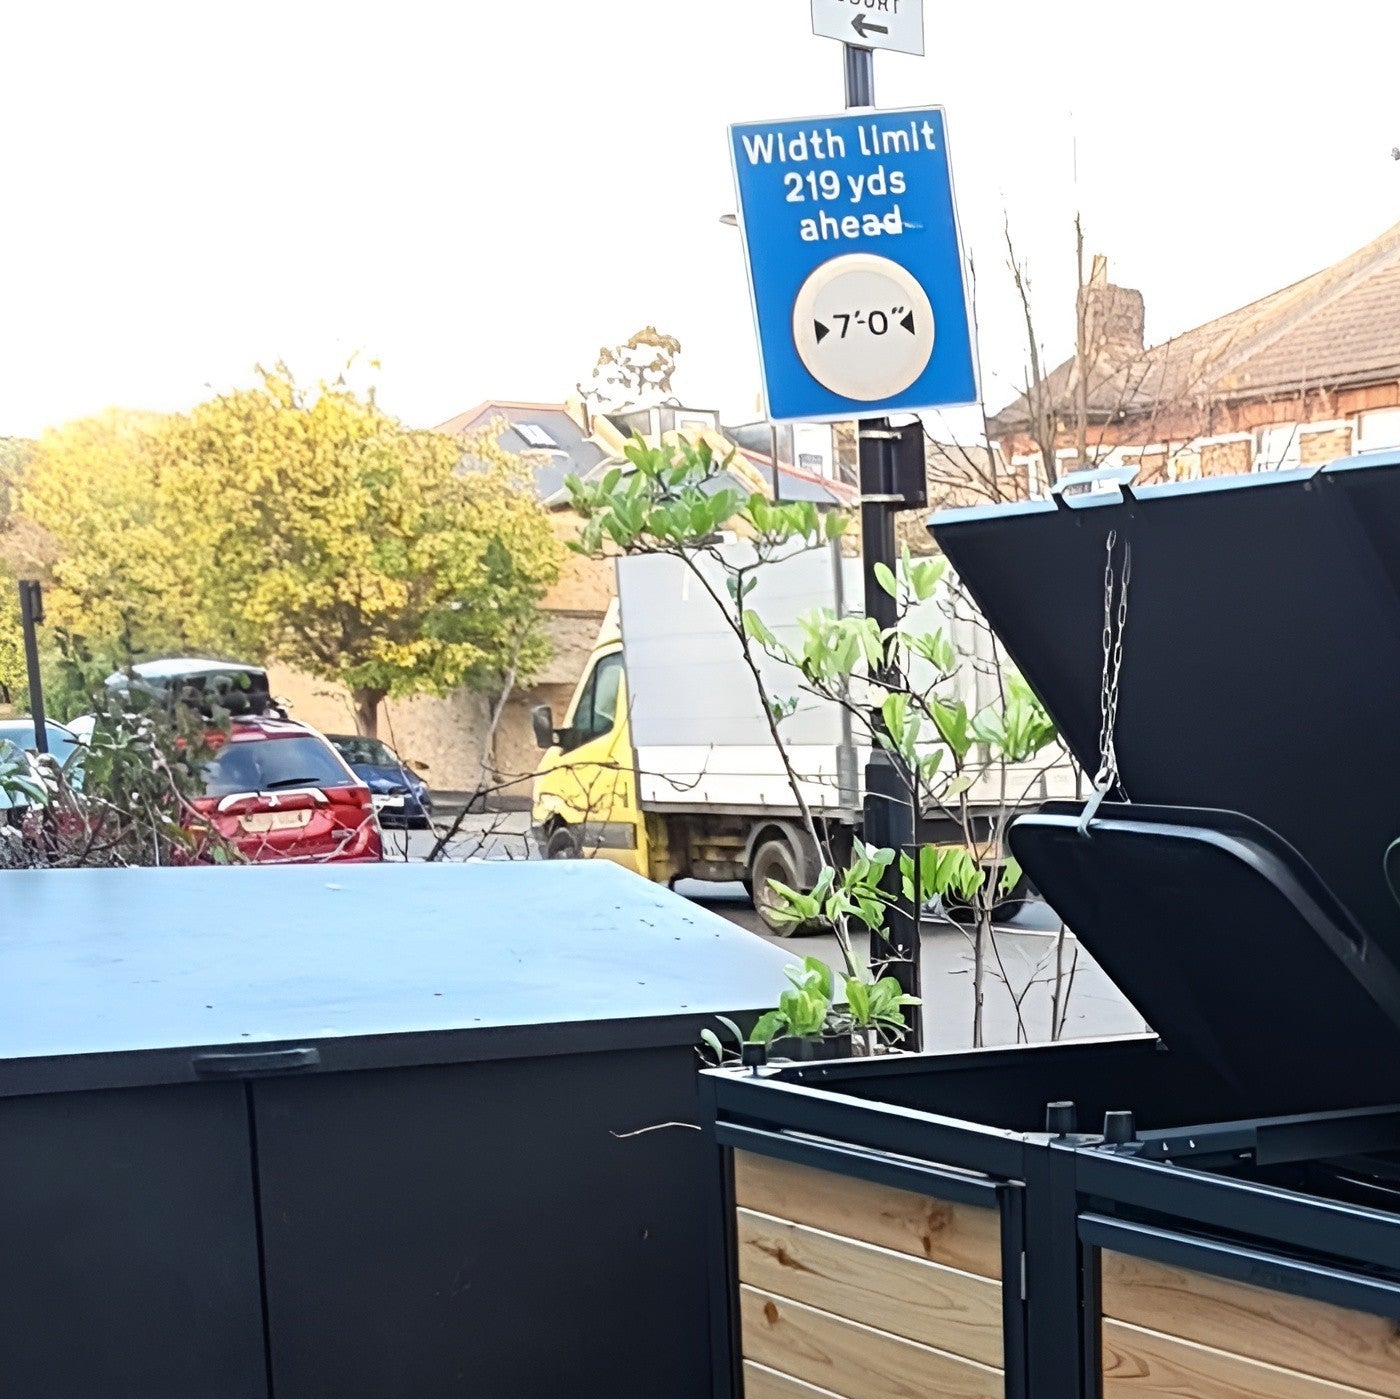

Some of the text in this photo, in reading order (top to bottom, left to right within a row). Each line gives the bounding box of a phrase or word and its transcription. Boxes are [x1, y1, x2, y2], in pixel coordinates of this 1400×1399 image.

[741, 120, 936, 165] Width limit
[784, 165, 906, 204] 219 yds
[800, 204, 903, 241] ahead
